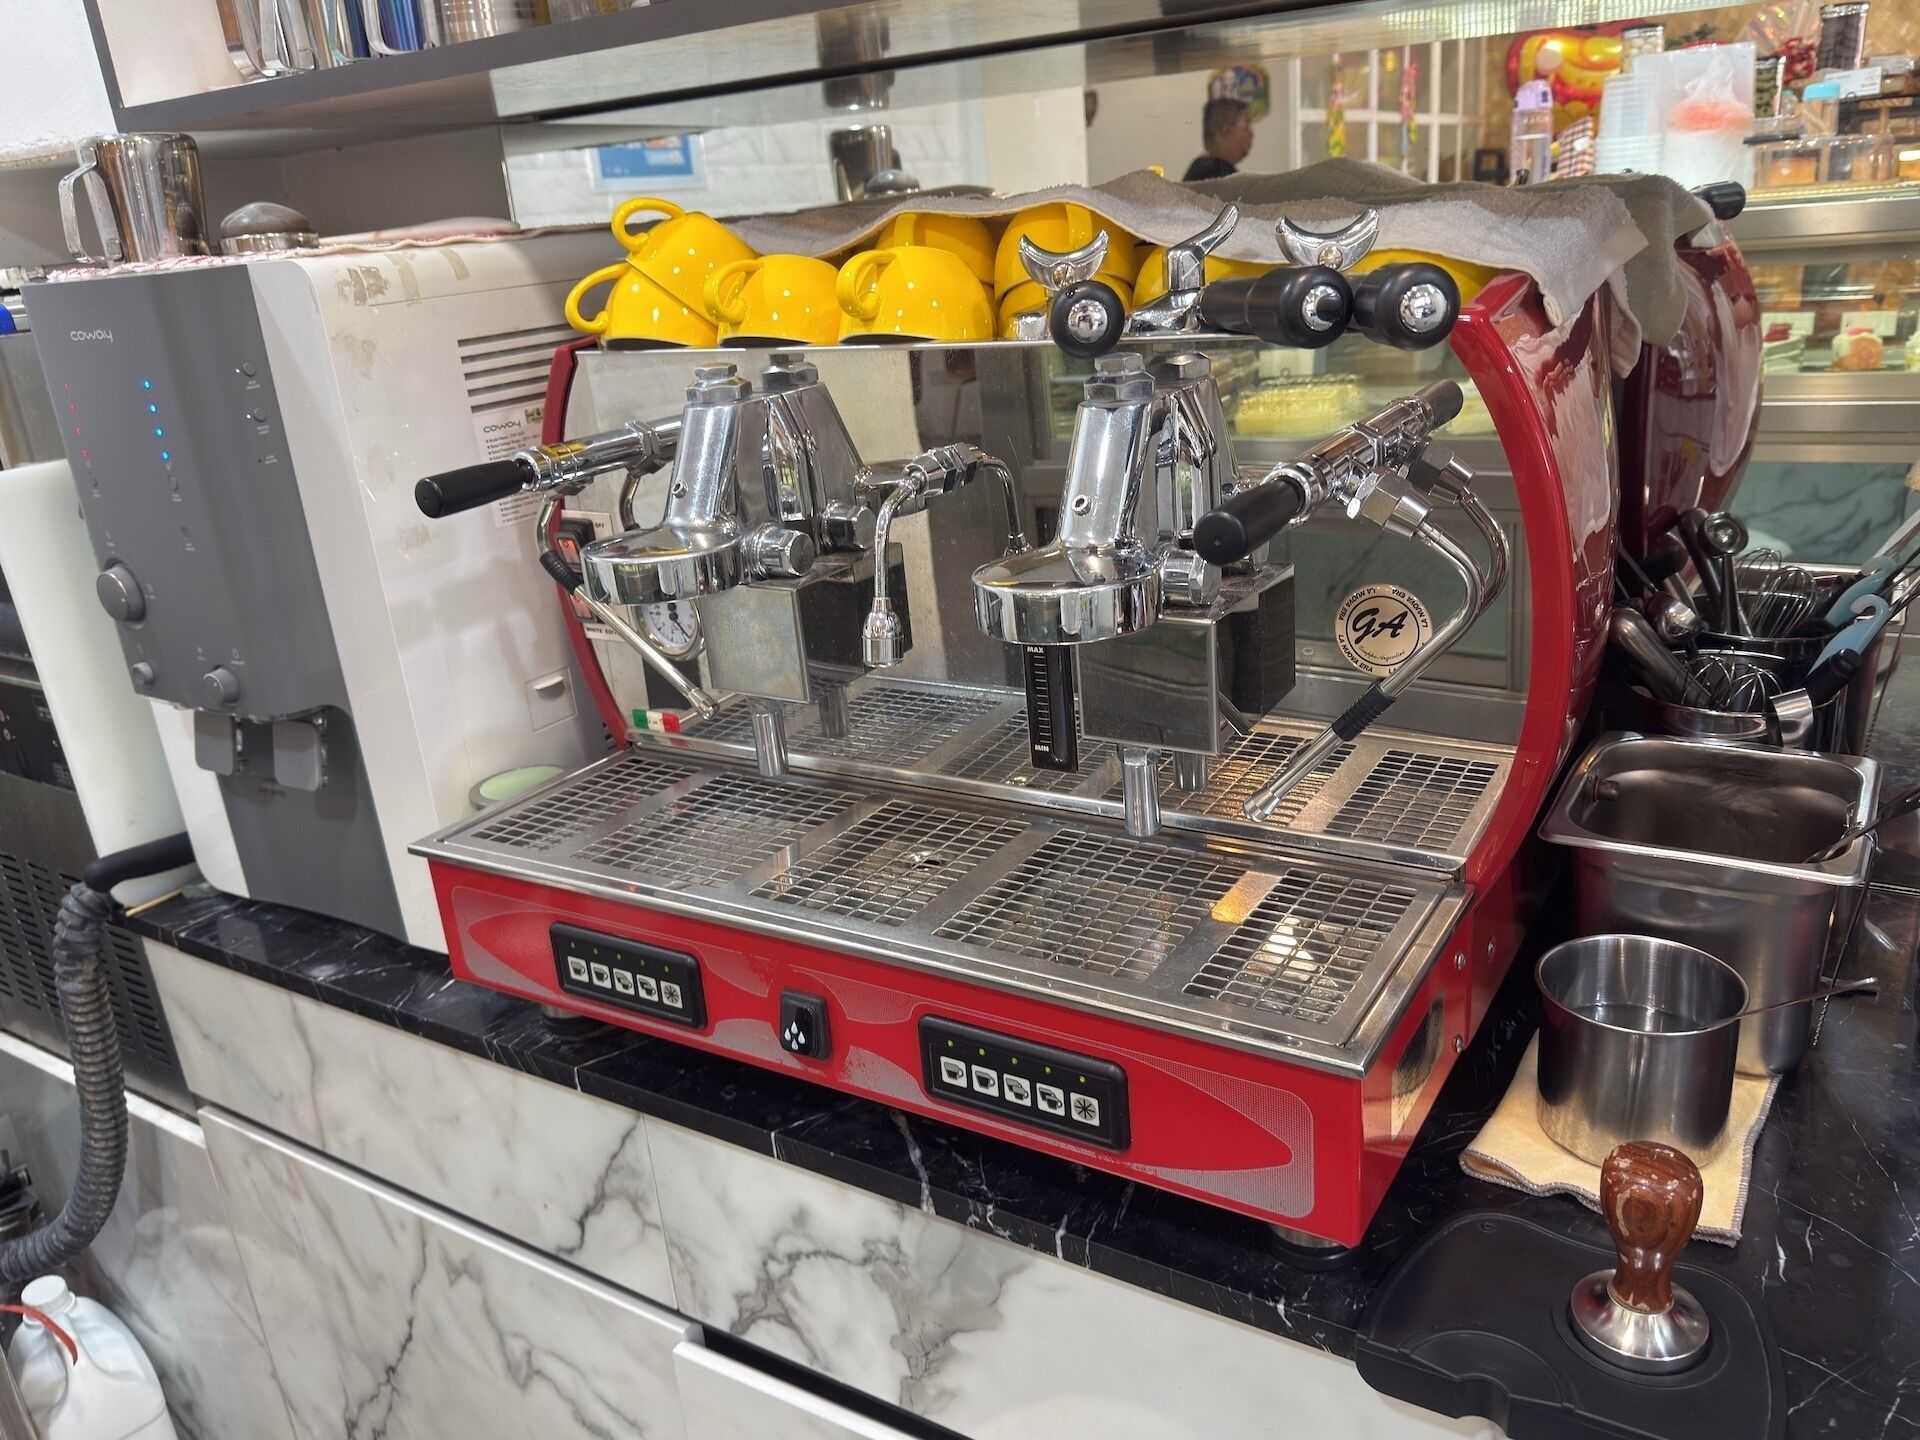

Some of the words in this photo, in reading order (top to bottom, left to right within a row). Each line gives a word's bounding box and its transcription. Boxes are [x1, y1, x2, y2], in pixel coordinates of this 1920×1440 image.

[70, 329, 114, 343] coway
[483, 420, 521, 433] coway
[1346, 589, 1366, 608] NUOVA
[1392, 589, 1406, 599] ERA
[1338, 607, 1348, 621] ERA
[1406, 597, 1425, 618] NUOVA
[1352, 607, 1408, 645] GA
[1421, 619, 1428, 628] LA
[1338, 634, 1345, 642] LA
[1341, 645, 1359, 664] NUOVA
[1359, 662, 1374, 673] ERA
[1034, 744, 1050, 752] MIN
